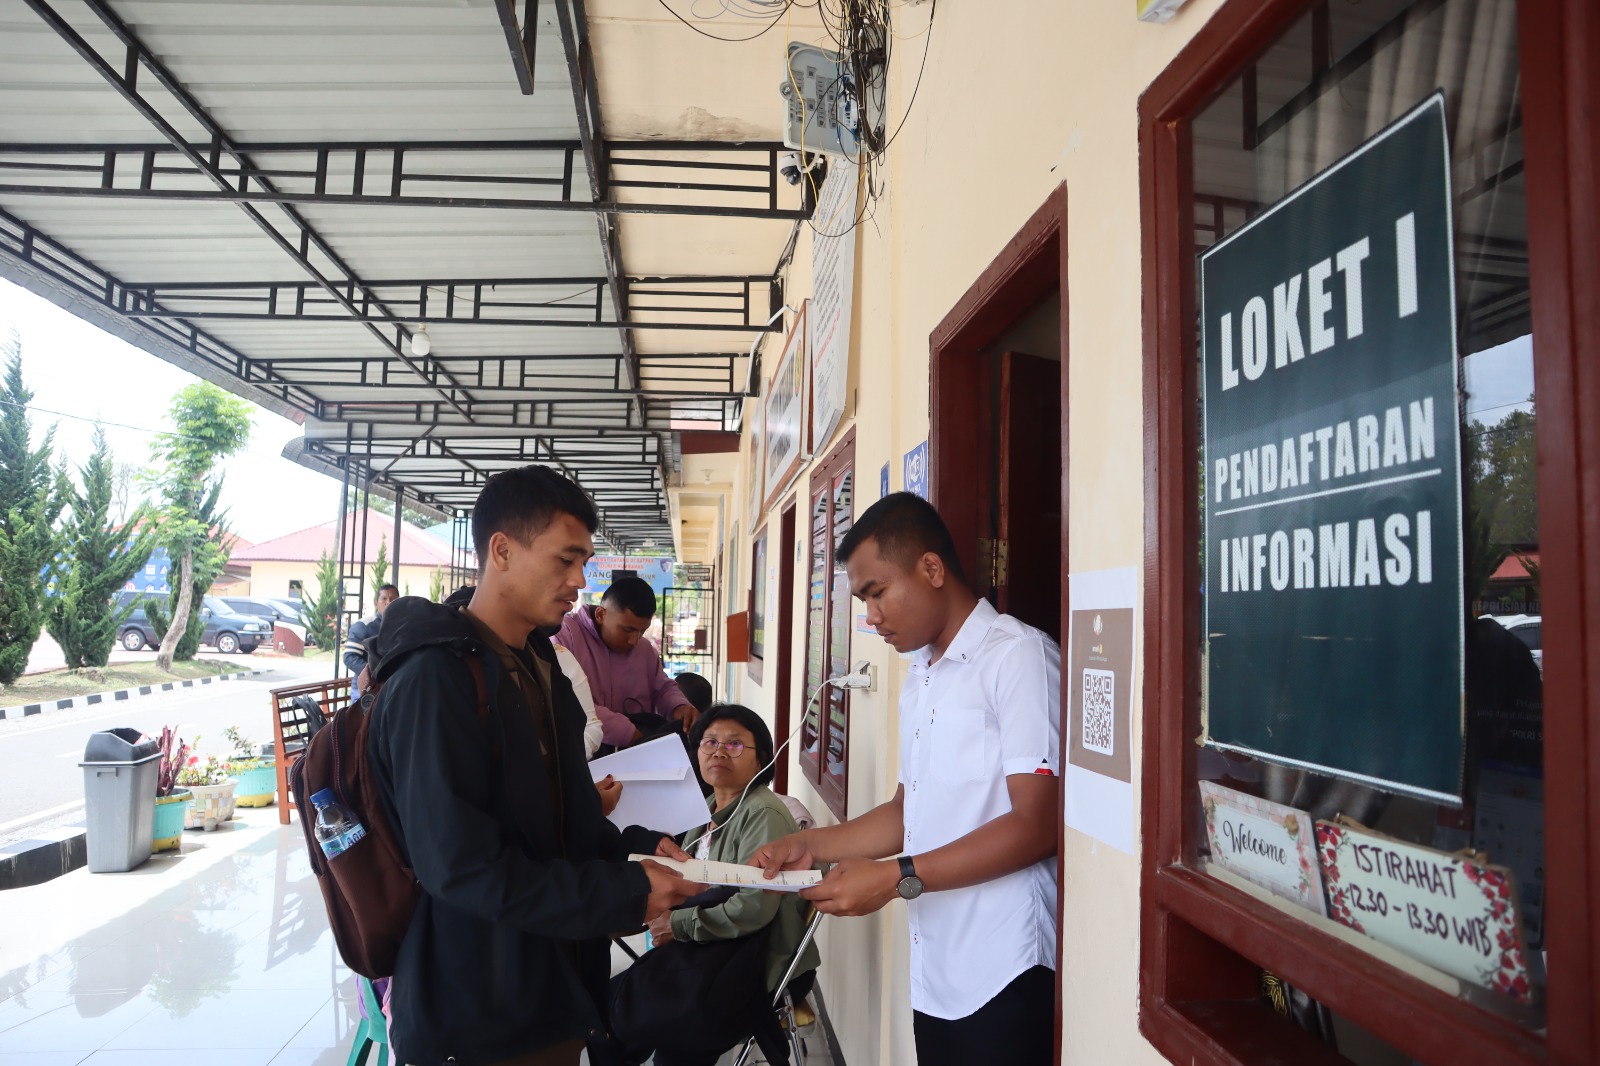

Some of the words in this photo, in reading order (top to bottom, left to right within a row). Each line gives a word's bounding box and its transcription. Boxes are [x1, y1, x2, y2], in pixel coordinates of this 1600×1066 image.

[1220, 236, 1370, 392] LOKET
[1395, 211, 1418, 318] I
[1214, 396, 1436, 503] PENDAFTARAN
[587, 571, 612, 579] JANG
[1220, 510, 1433, 592] INFORMASI
[1223, 820, 1287, 865] Welcome
[1353, 843, 1457, 900] ISTIRAHAT
[1453, 916, 1492, 957] WIB
